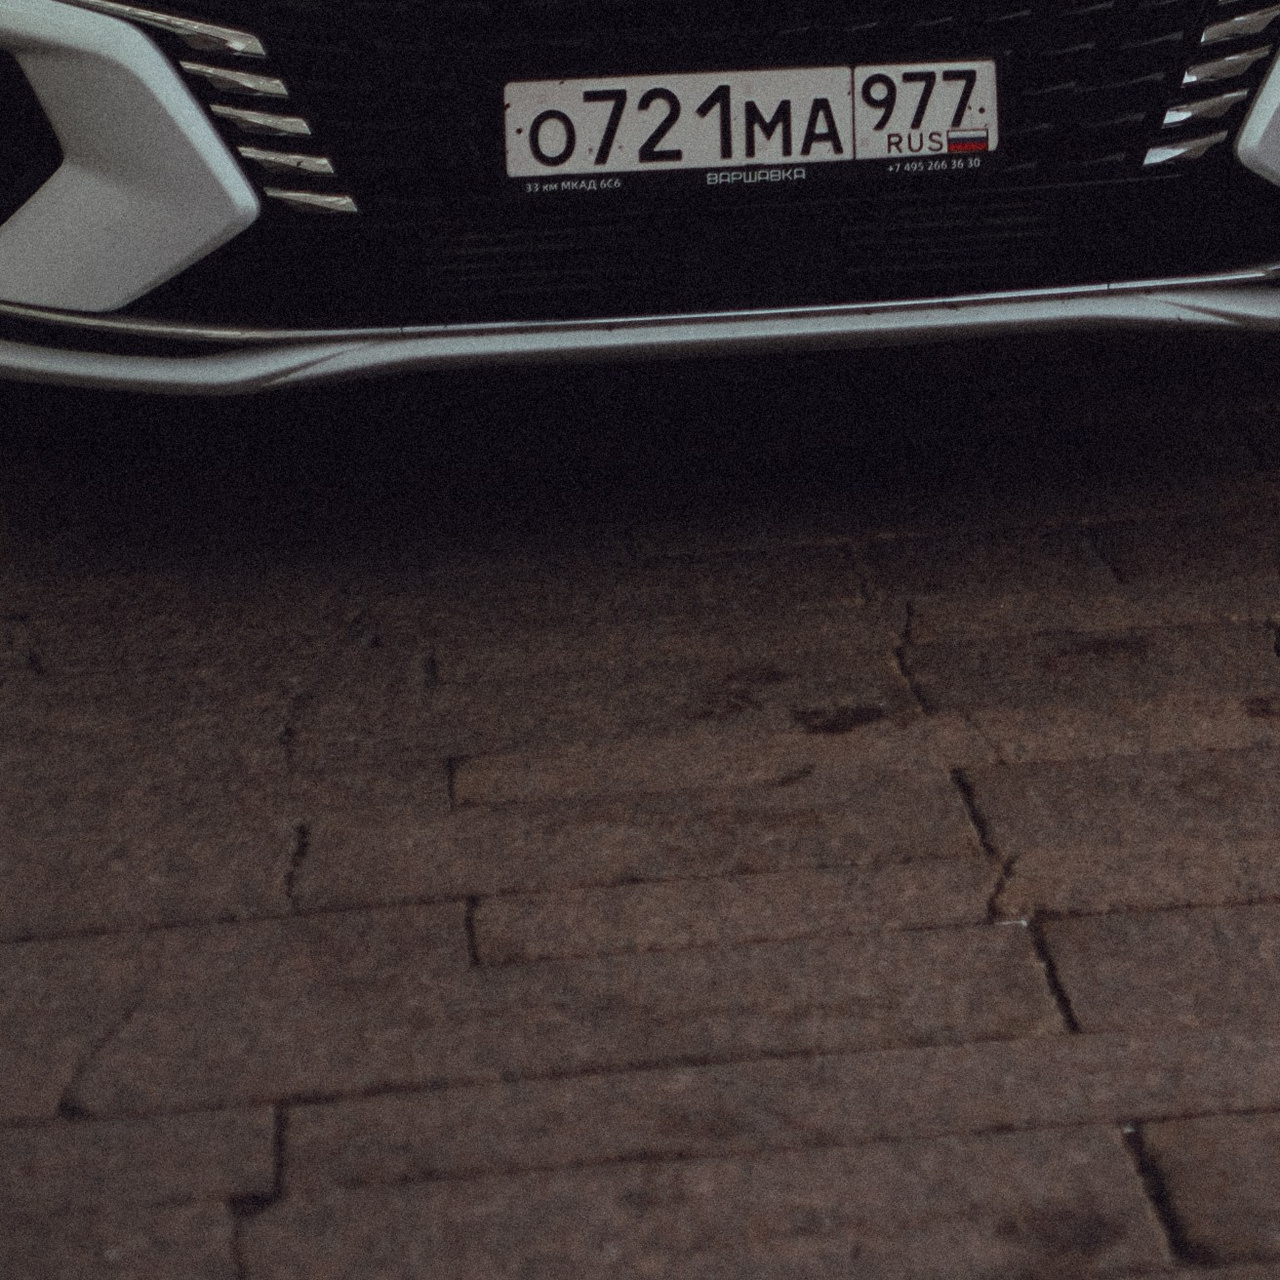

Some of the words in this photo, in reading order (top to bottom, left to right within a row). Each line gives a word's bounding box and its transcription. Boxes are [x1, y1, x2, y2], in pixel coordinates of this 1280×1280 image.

[860, 69, 980, 132] 977
[886, 131, 943, 154] RUS
[903, 161, 924, 172] 495
[927, 159, 948, 171] 266
[951, 158, 964, 170] 36
[967, 157, 982, 169] 30
[560, 179, 598, 192] МКАД
[706, 167, 807, 186] ВАРШАВКА
